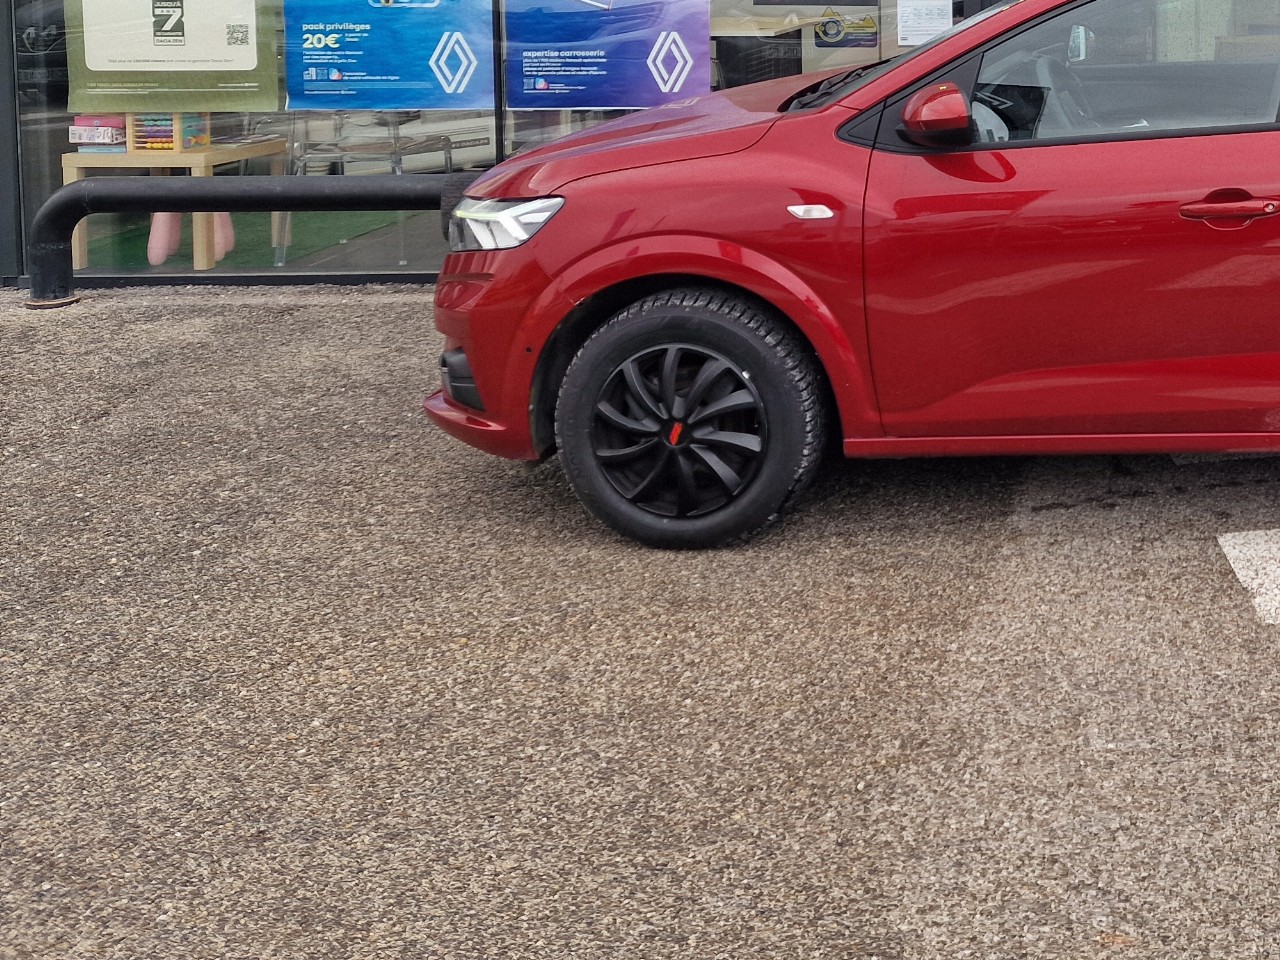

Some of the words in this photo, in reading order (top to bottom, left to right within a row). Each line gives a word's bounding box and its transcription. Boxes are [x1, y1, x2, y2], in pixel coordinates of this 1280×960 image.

[154, 7, 182, 31] 7
[302, 22, 325, 31] pack
[325, 22, 371, 32] privilèges
[522, 49, 560, 58] expertise
[560, 49, 605, 57] carrosserie
